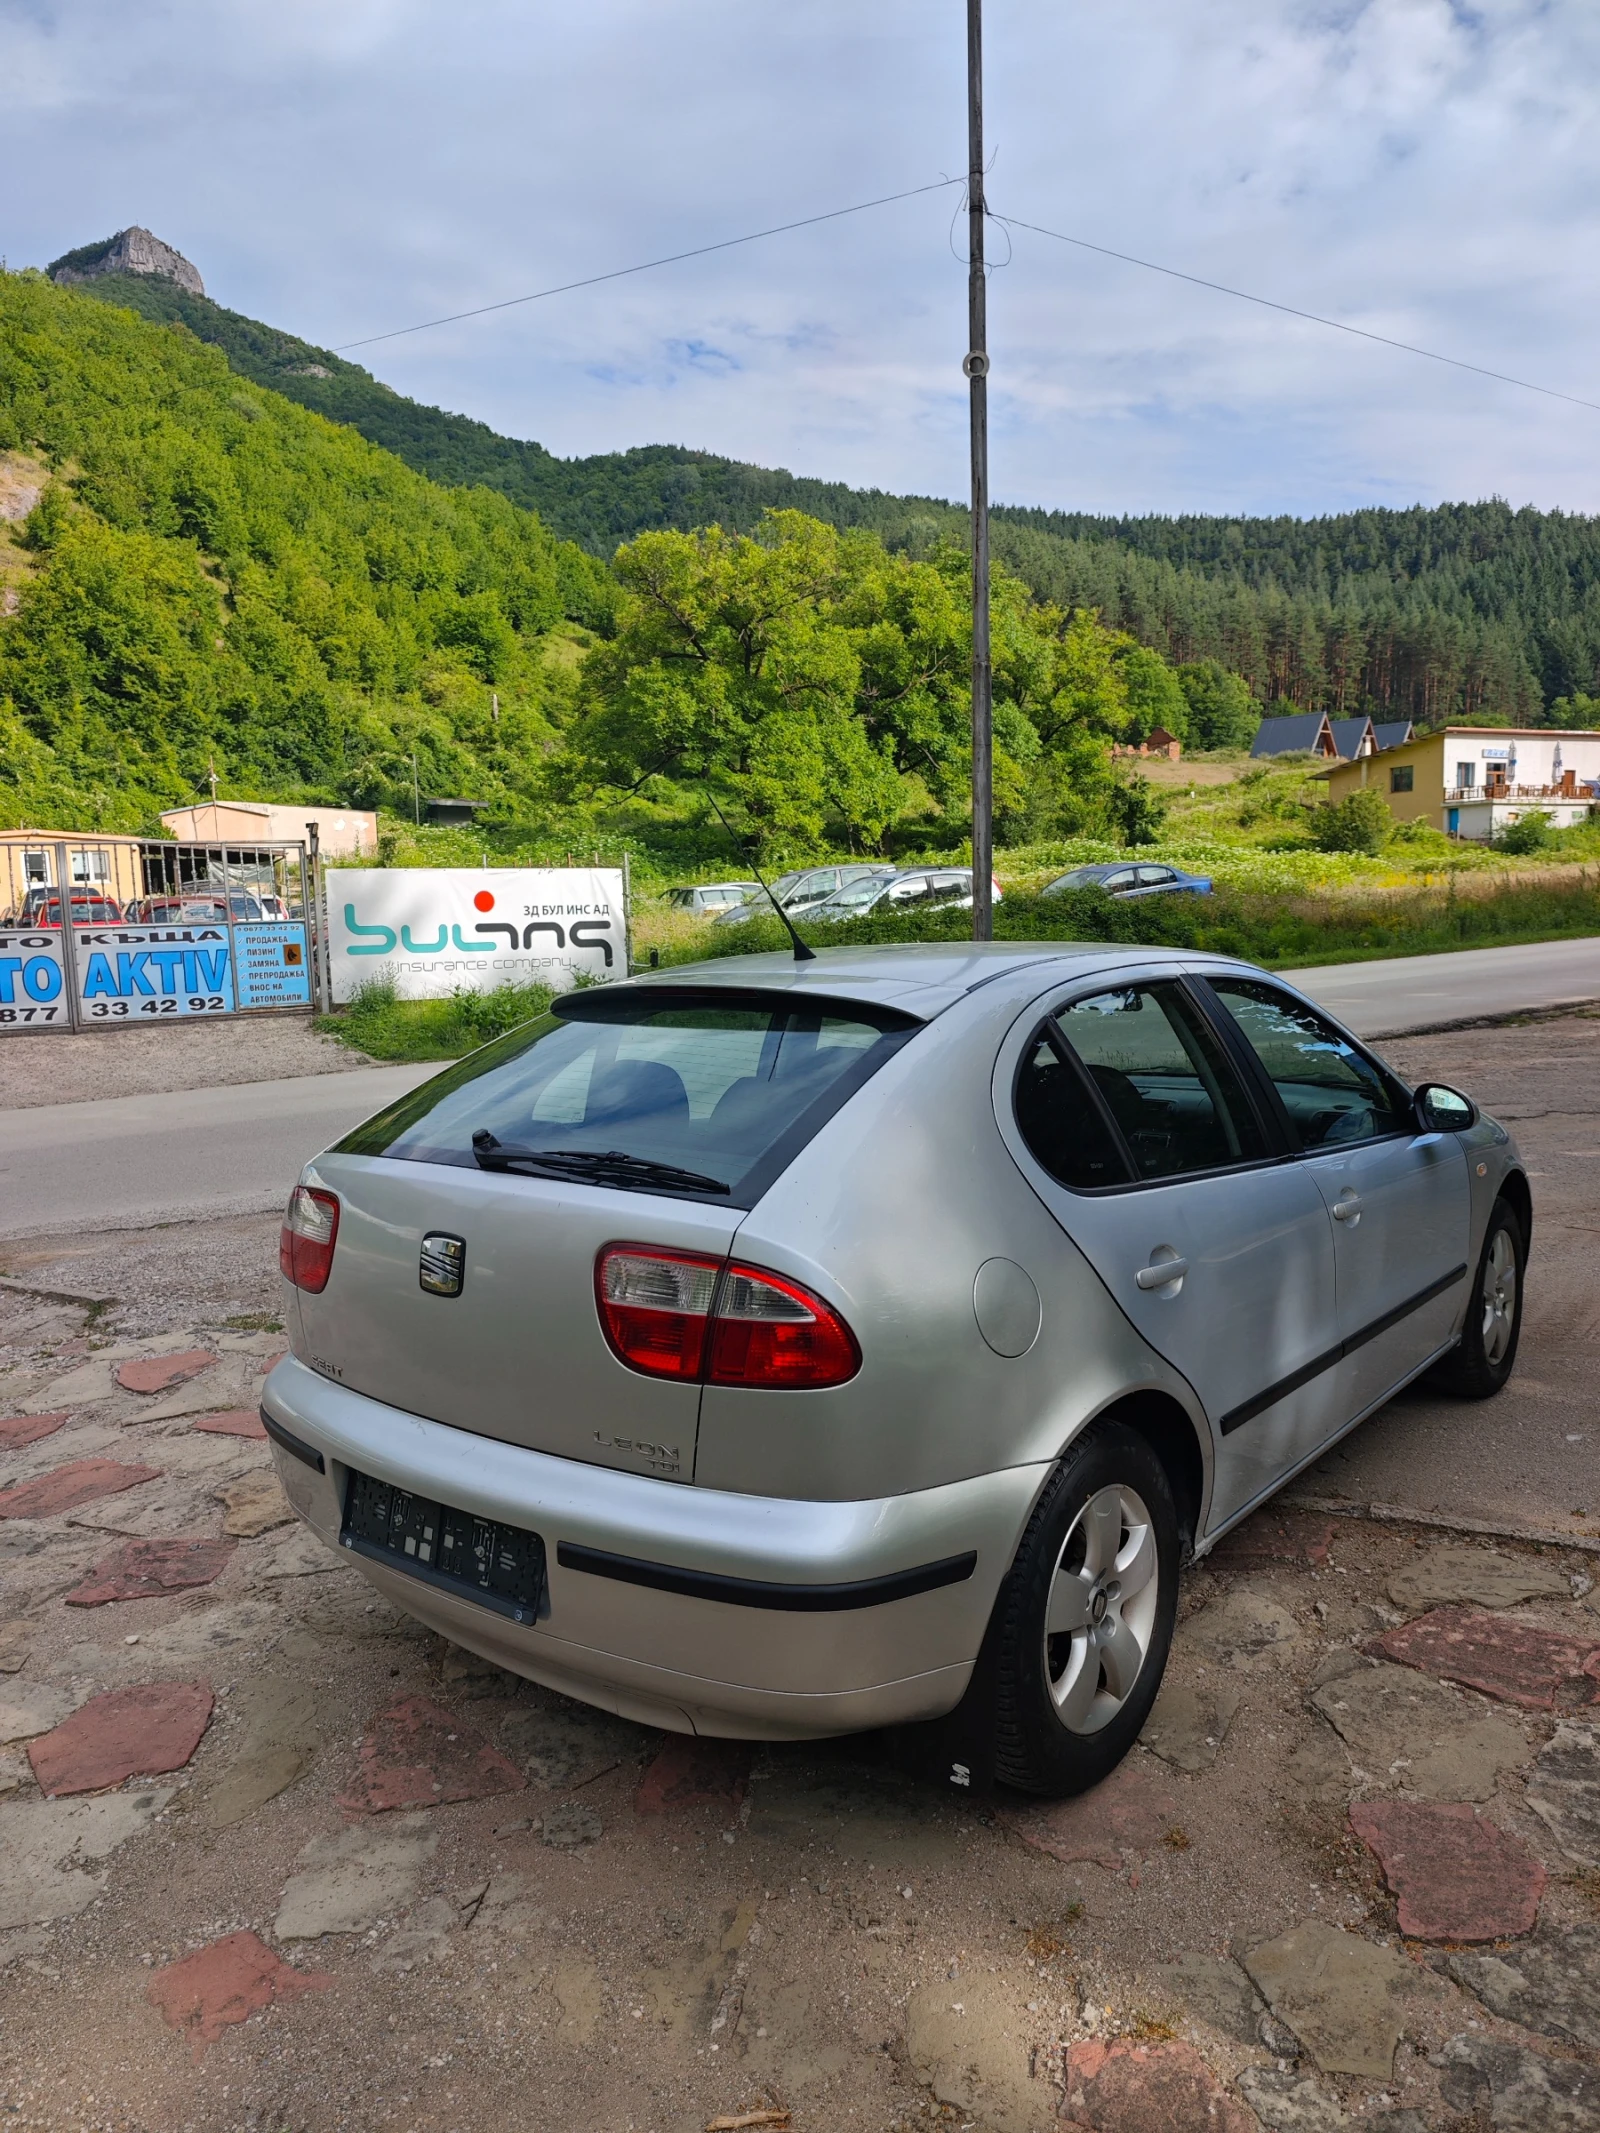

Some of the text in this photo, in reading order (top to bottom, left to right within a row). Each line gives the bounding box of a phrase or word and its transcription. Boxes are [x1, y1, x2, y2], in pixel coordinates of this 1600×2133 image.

[523, 904, 611, 918] ЗД БУЛ ИНС АД
[80, 930, 224, 945] КЪЩА
[246, 936, 288, 944] ПРОДАЖБА
[247, 960, 280, 968] ЗАМЯНА
[397, 957, 573, 973] insurance company
[83, 949, 228, 998] AKTIV
[248, 970, 305, 980] ПРЕПРОДАЖБА
[249, 984, 271, 992] ВНОС
[250, 994, 302, 1003] АВТОМОБИЛИ
[91, 1002, 129, 1017] 33
[140, 999, 177, 1013] 42
[188, 996, 225, 1011] 92
[593, 1430, 679, 1460] LEON
[645, 1457, 680, 1473] TDI
